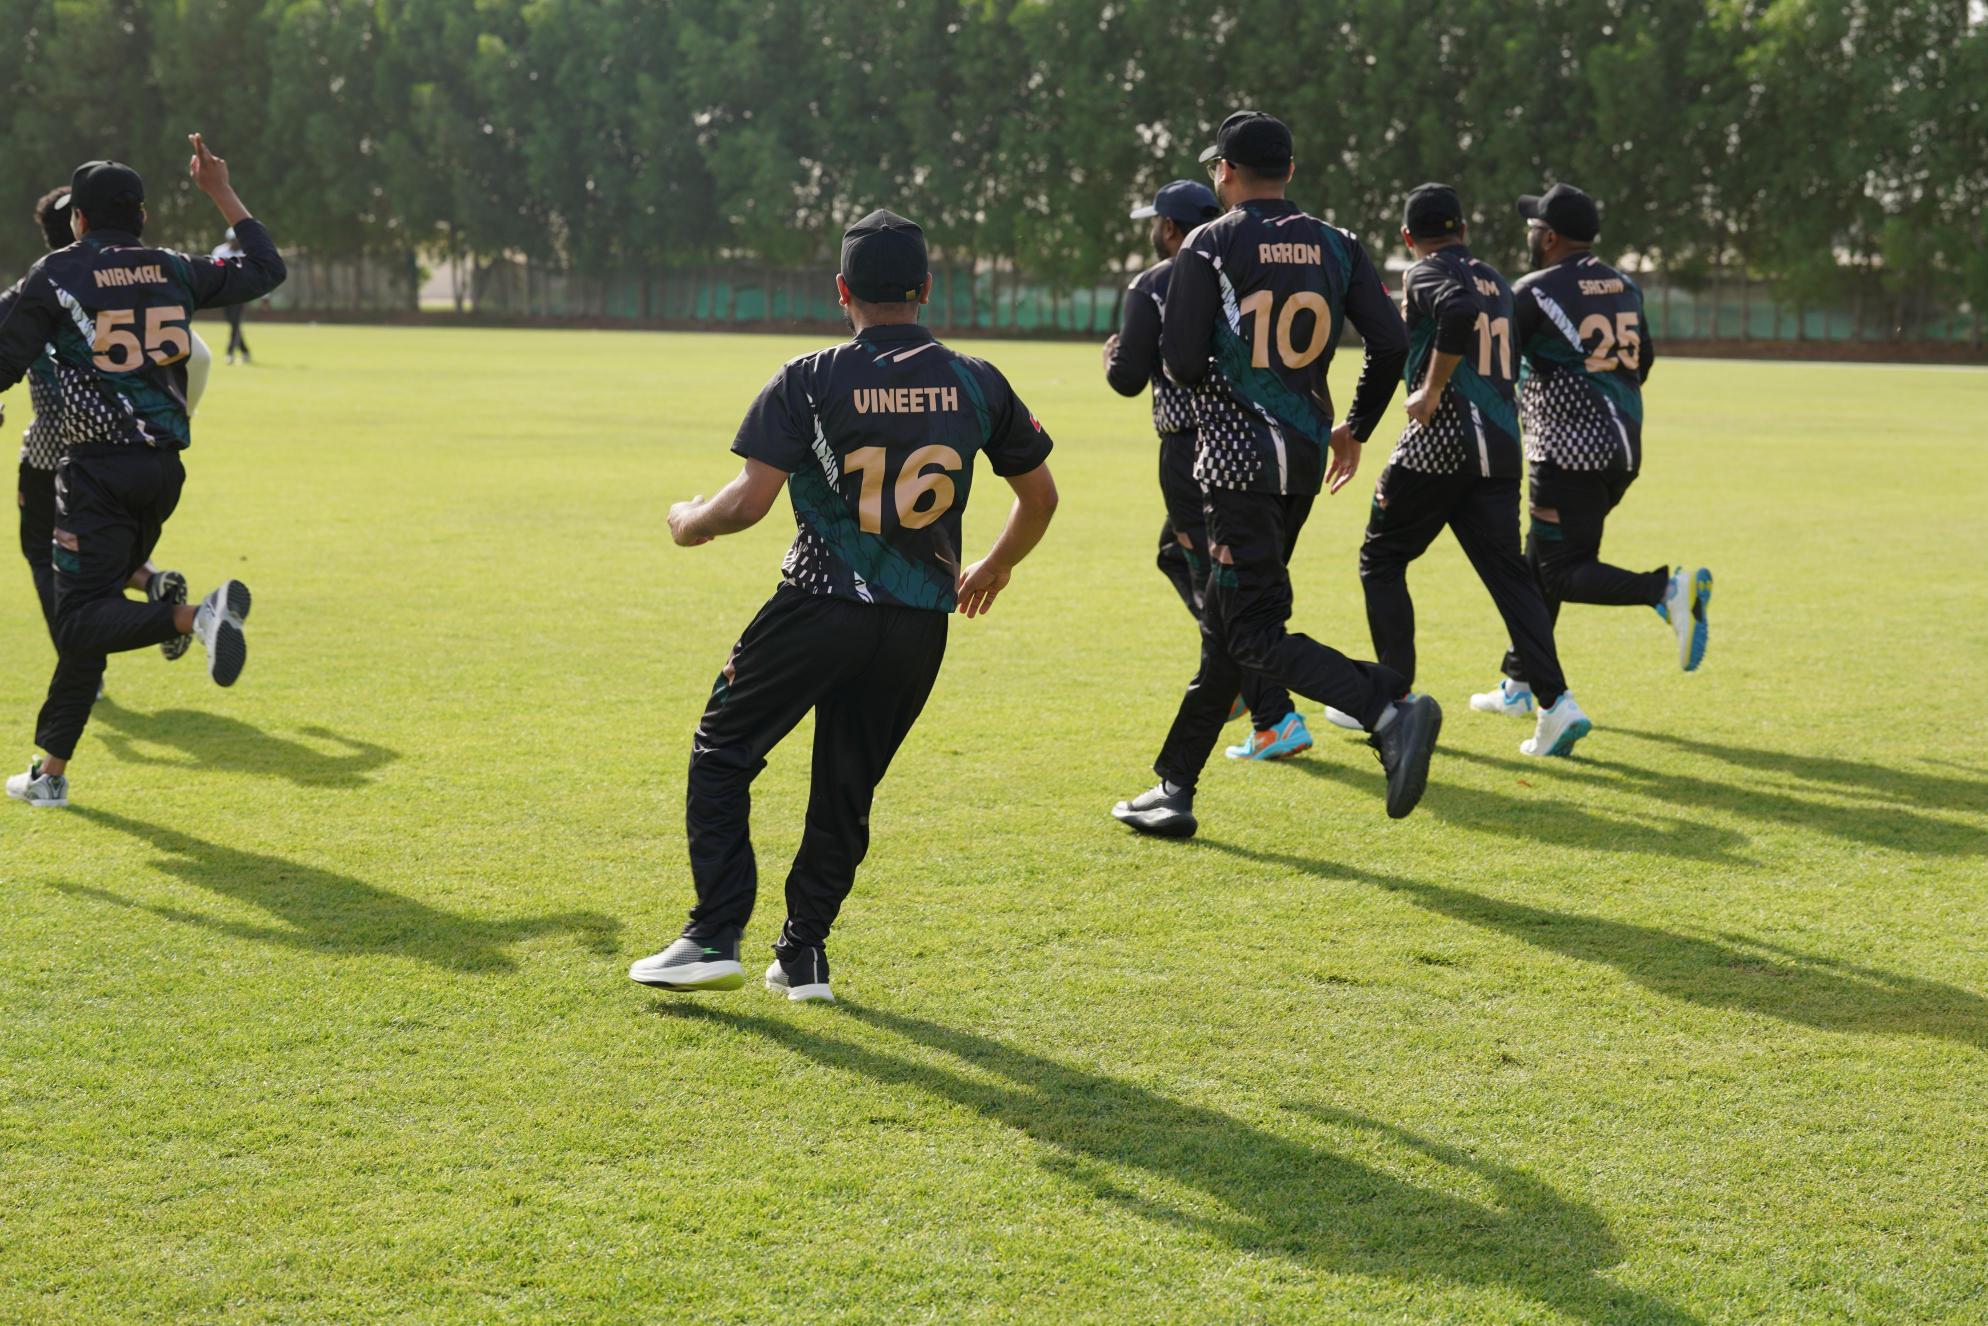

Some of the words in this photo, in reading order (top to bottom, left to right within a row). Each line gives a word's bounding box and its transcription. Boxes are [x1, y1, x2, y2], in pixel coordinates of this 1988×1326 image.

[93, 265, 168, 288] NIRMAL
[1258, 243, 1321, 265] AARON
[92, 305, 190, 373] 55
[1240, 290, 1332, 369] 10
[1473, 312, 1512, 380] 11
[1578, 312, 1640, 373] 25
[853, 387, 959, 414] VINEETH
[843, 444, 963, 535] 16
